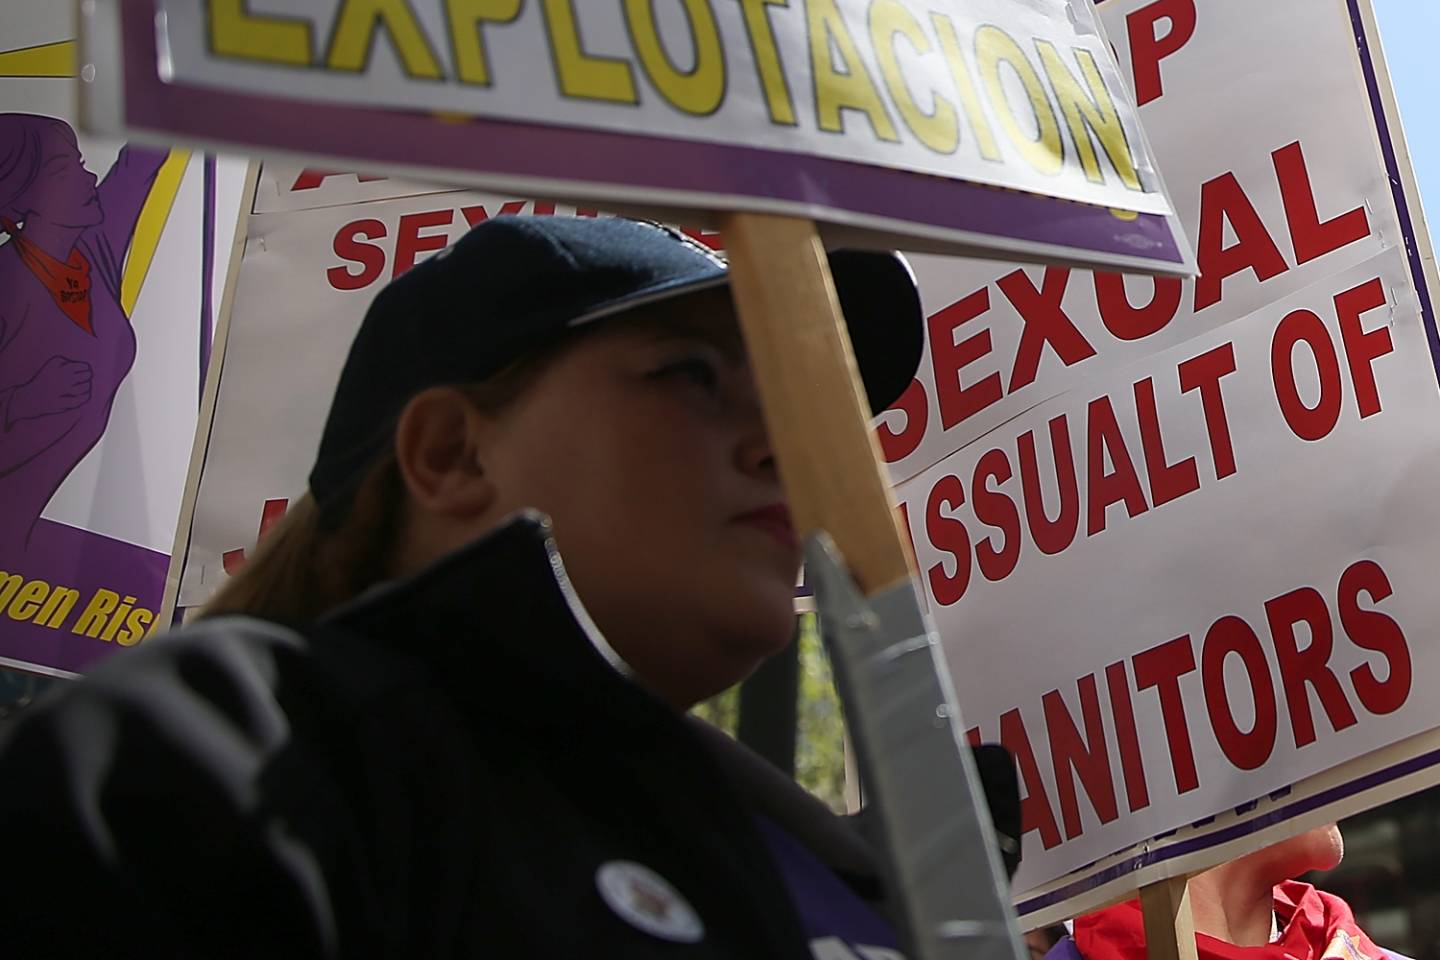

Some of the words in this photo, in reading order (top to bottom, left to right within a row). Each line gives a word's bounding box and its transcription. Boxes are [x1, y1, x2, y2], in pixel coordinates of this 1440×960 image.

[1270, 276, 1394, 442] OF
[896, 341, 1237, 616] SSUALT
[71, 588, 161, 647] Ris
[964, 559, 1413, 863] ANITORS
